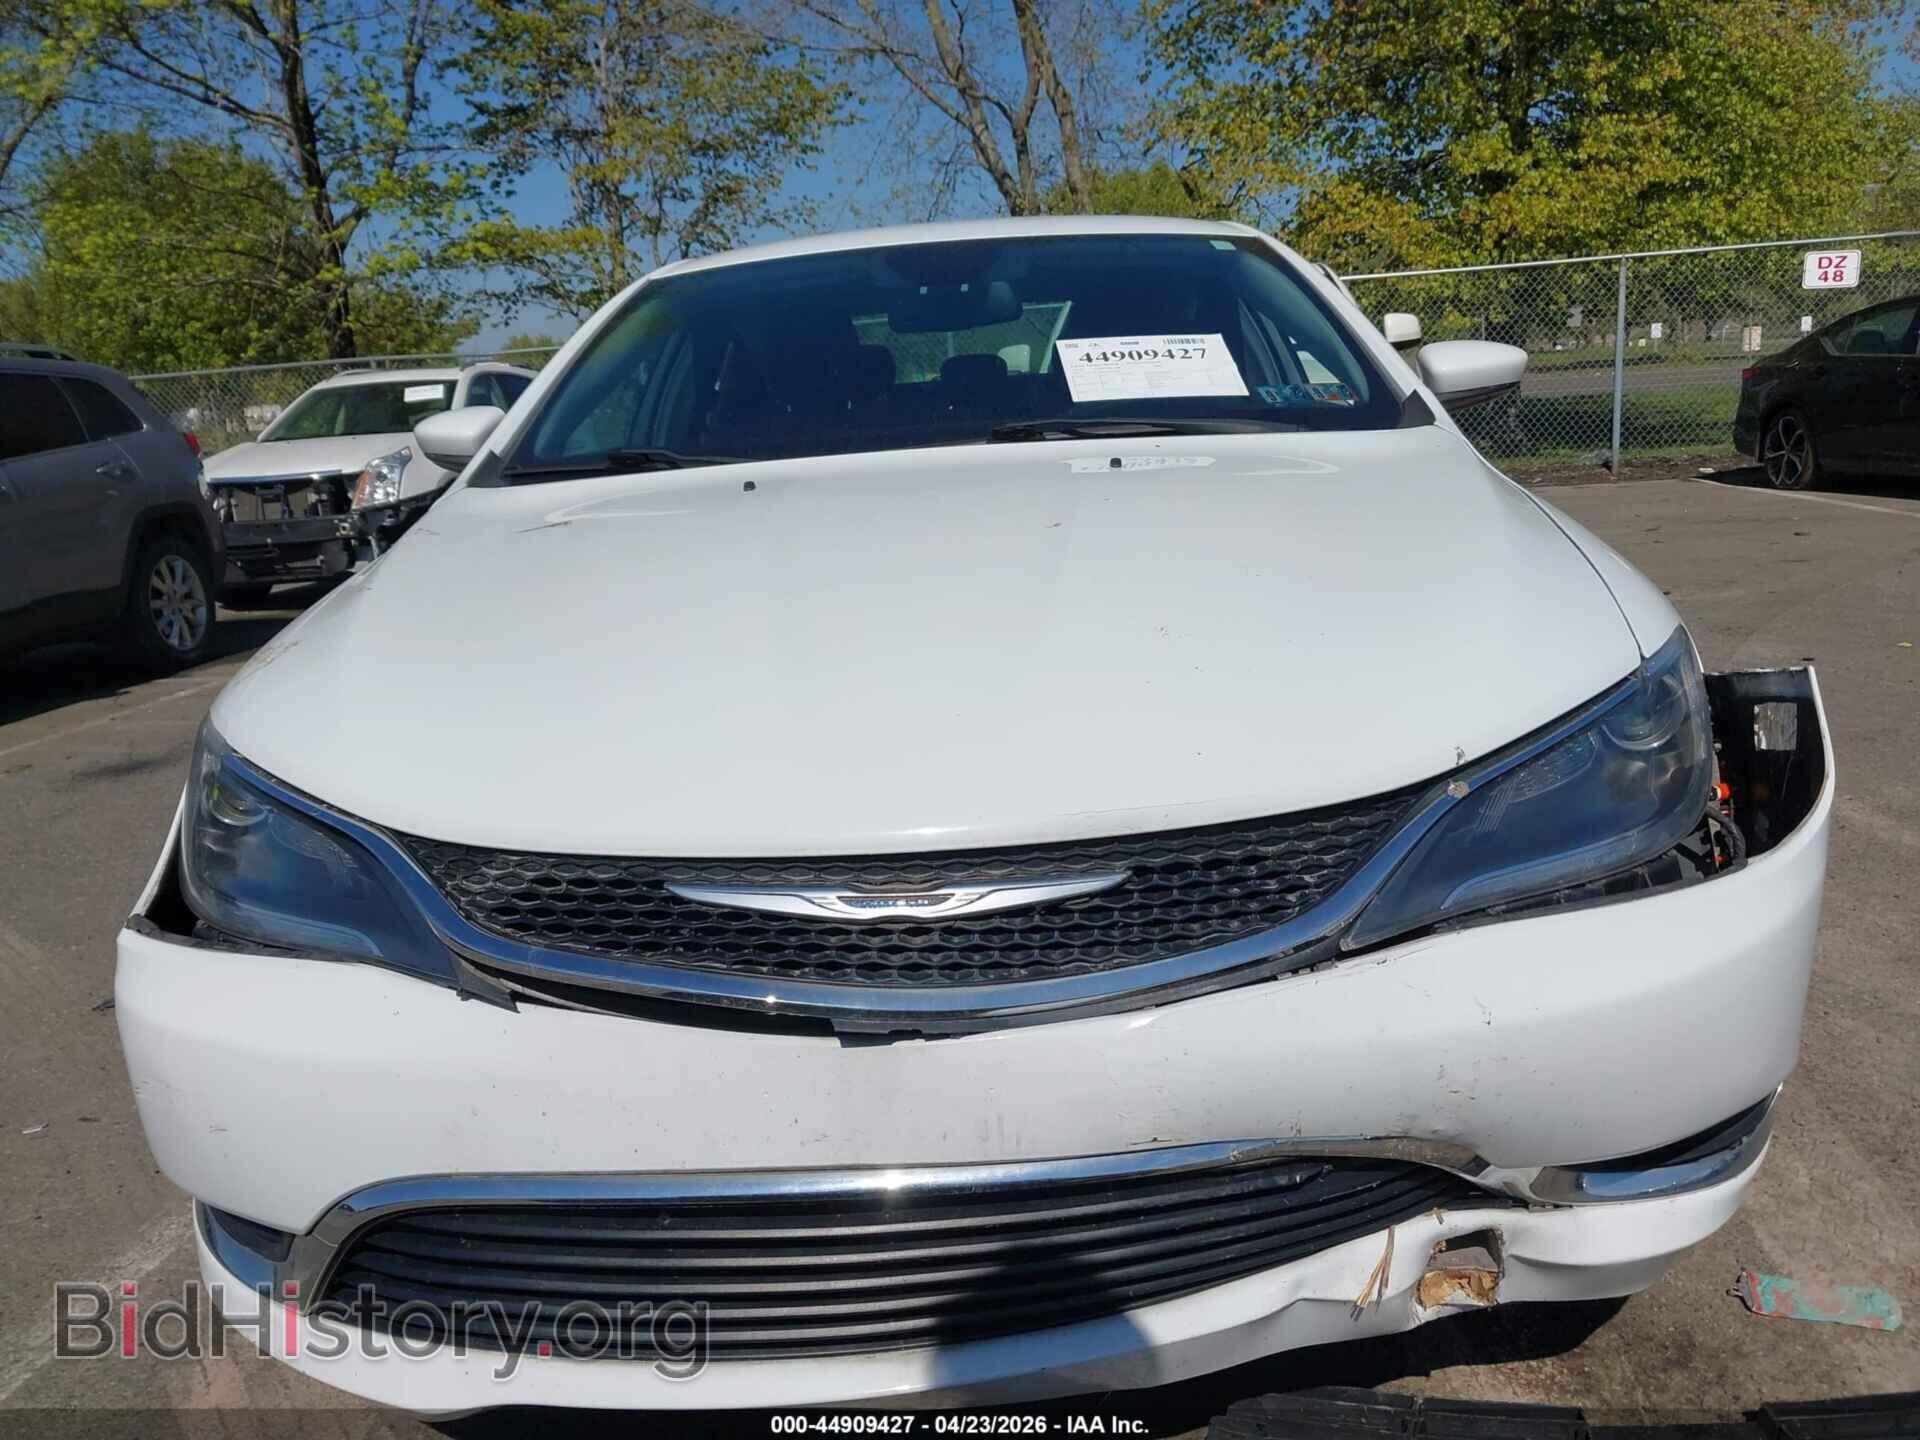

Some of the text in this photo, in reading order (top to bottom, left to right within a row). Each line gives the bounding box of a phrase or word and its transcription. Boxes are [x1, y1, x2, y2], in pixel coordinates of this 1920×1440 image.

[1817, 255, 1848, 269] DZ
[1817, 270, 1844, 283] 48
[1079, 347, 1207, 363] 44909427
